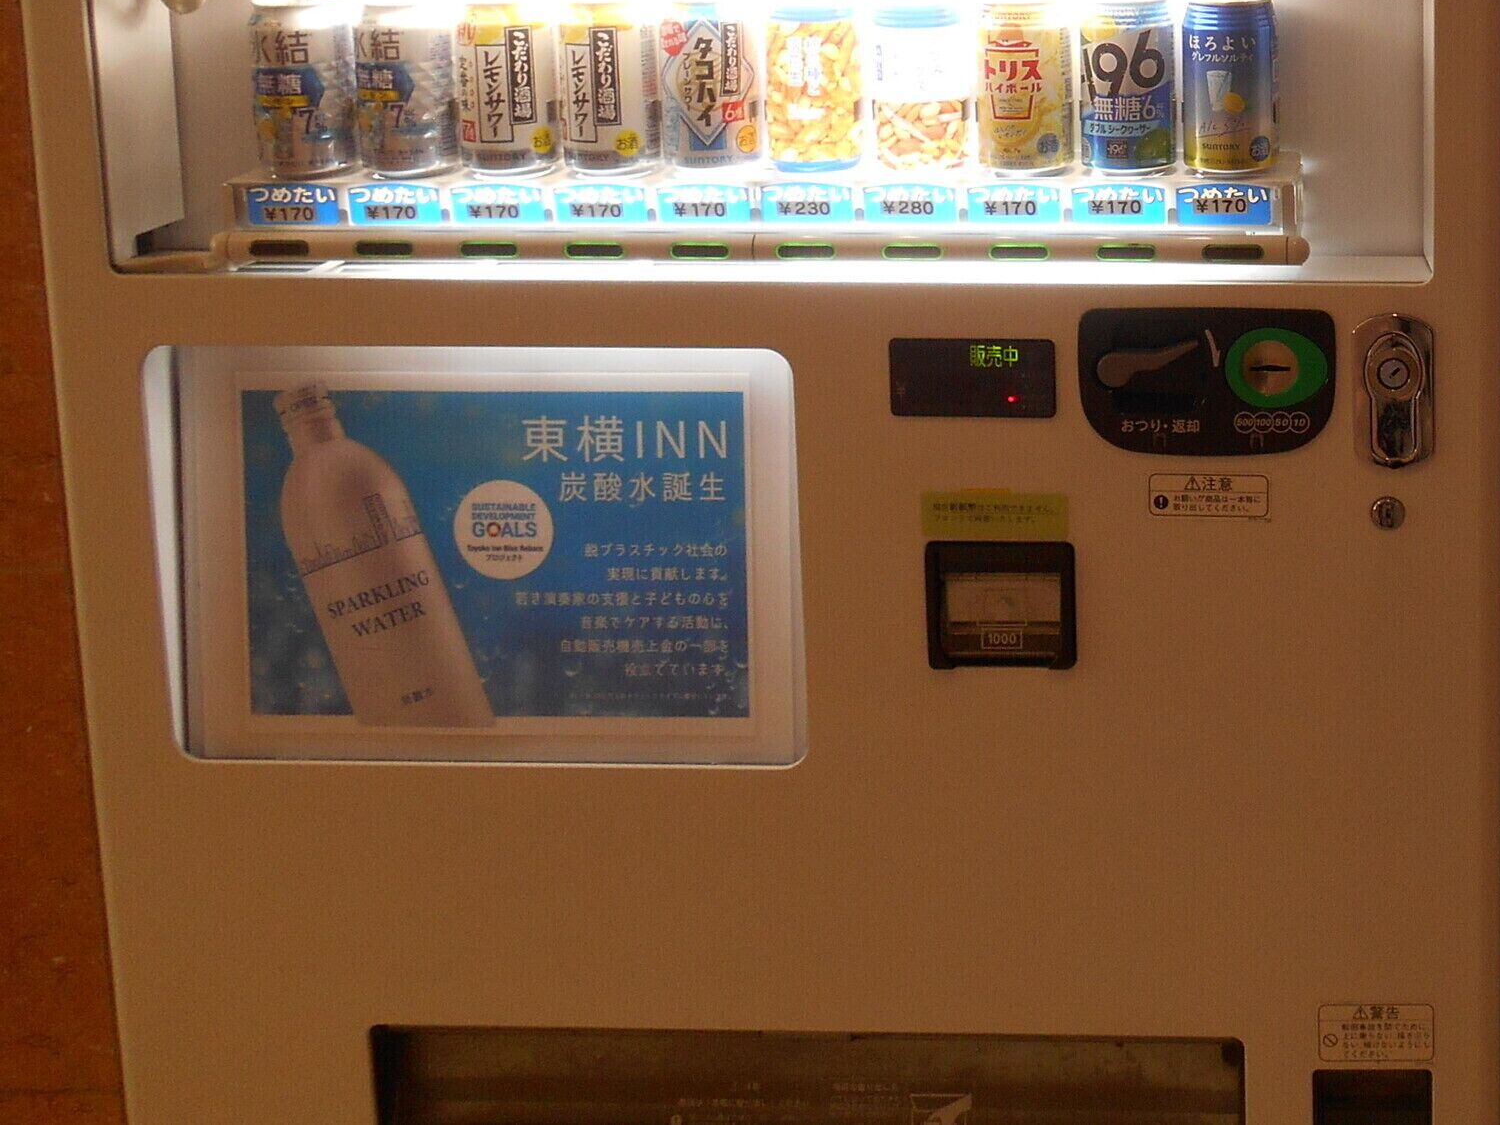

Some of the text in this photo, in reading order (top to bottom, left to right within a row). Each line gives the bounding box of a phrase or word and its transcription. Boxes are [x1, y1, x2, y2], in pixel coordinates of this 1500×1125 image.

[1189, 34, 1256, 50] ほろよい
[724, 25, 738, 93] こだわり酒場
[595, 32, 618, 122] こだわり酒場
[984, 60, 1042, 82] トリス
[694, 37, 715, 127] タコハイ
[985, 82, 1042, 94] ハイボール
[572, 51, 592, 138] レモンサワー
[1093, 96, 1140, 122] 無糖
[1178, 188, 1268, 204] つめたい
[367, 206, 416, 220] ¥170
[673, 202, 725, 218] ¥170
[883, 201, 934, 216] ¥280
[1196, 198, 1247, 214] ¥170
[970, 345, 1018, 368] 販売中
[1236, 418, 1307, 427] 500 100 50 10
[521, 416, 728, 462] 東横INN
[559, 472, 726, 502] 炭酸水誕生
[1202, 477, 1232, 491] 注意
[471, 503, 537, 511] SUSTAINABLE
[471, 512, 536, 520] DEVELOPMENT
[473, 522, 537, 538] GOALS
[584, 544, 727, 557] 脱プラスチック社会の
[607, 567, 727, 581] 実現に貢献します。
[328, 571, 429, 619] SPARKLING
[352, 601, 427, 638] WATER
[987, 633, 1018, 645] 1000
